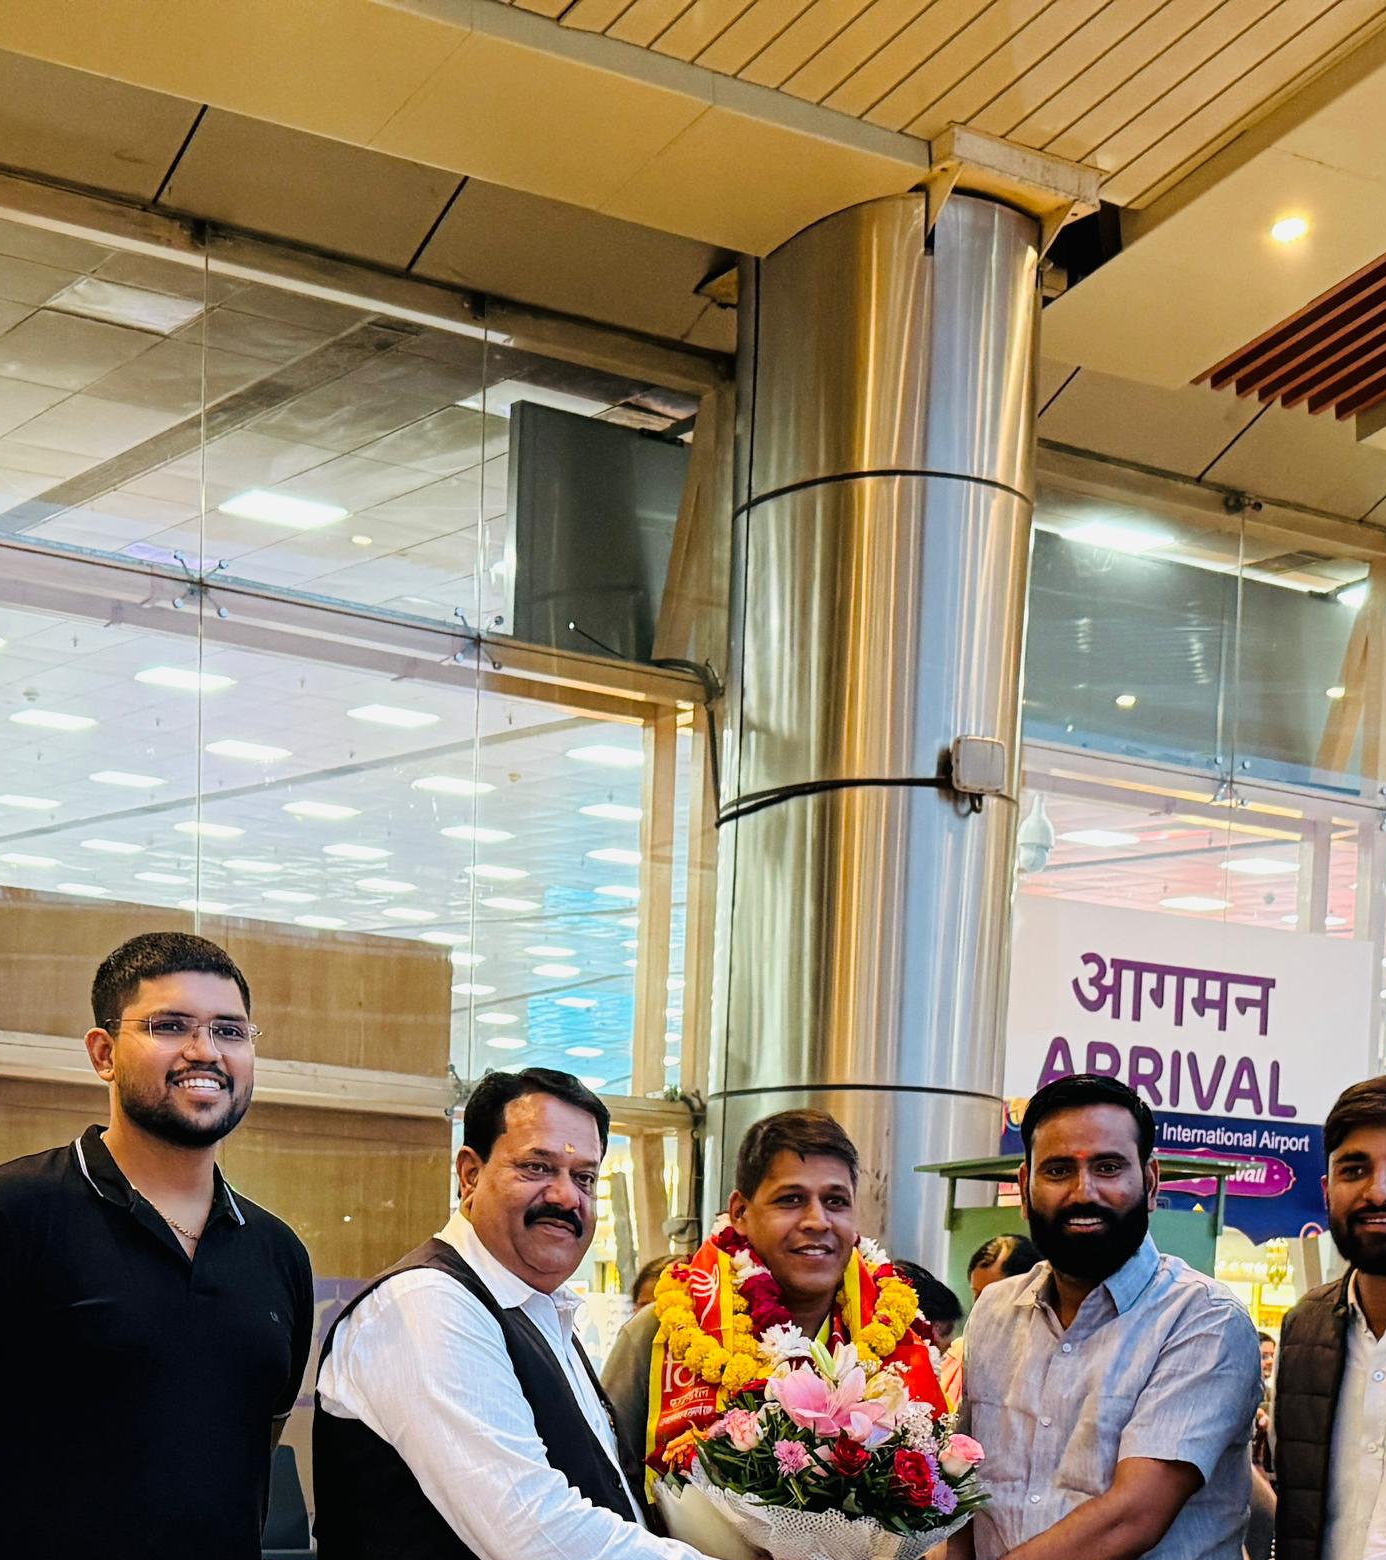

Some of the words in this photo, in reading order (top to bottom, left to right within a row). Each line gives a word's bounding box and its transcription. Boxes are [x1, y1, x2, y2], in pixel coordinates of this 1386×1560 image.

[1072, 952, 1276, 1036] आगमन
[1163, 1122, 1256, 1148] International
[1259, 1130, 1310, 1154] Airport
